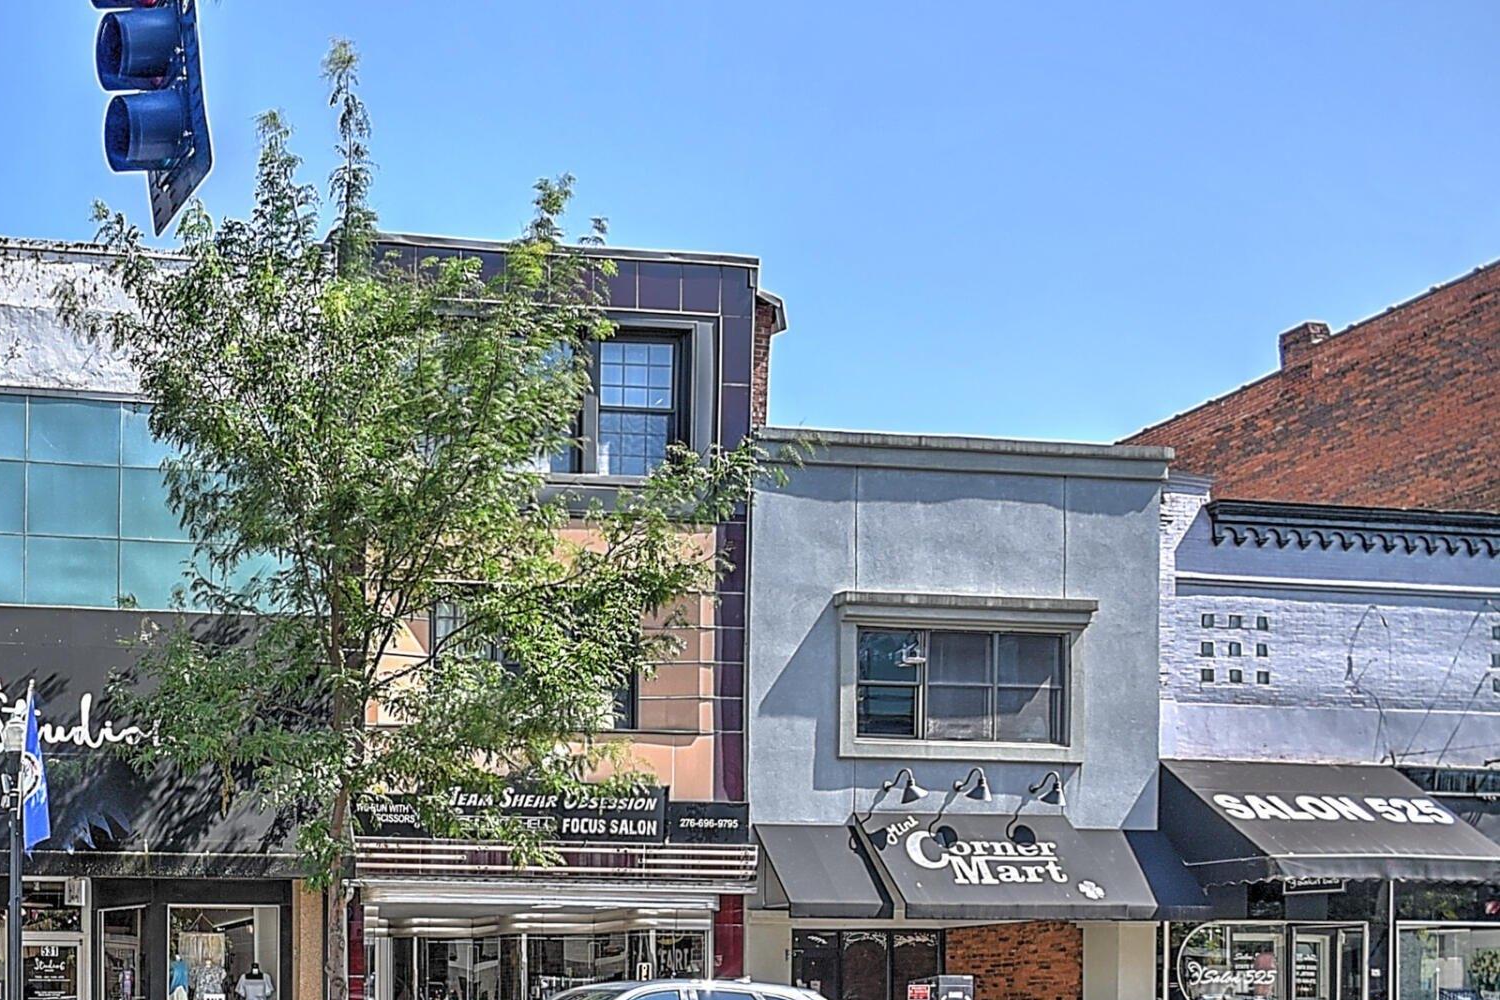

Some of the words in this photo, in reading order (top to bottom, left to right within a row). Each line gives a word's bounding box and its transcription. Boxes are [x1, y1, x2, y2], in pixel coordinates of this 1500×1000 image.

[389, 804, 409, 813] WITH
[1213, 794, 1376, 821] SALON
[1363, 798, 1454, 824] 525
[377, 813, 415, 823] SCISSORS
[679, 818, 739, 829] 276-696-9795
[562, 818, 606, 834] FOCUS
[609, 819, 657, 836] SALON
[906, 830, 1056, 869] Corner
[950, 855, 1068, 885] Mart
[1200, 970, 1245, 984] Salon
[1244, 970, 1277, 985] 525
